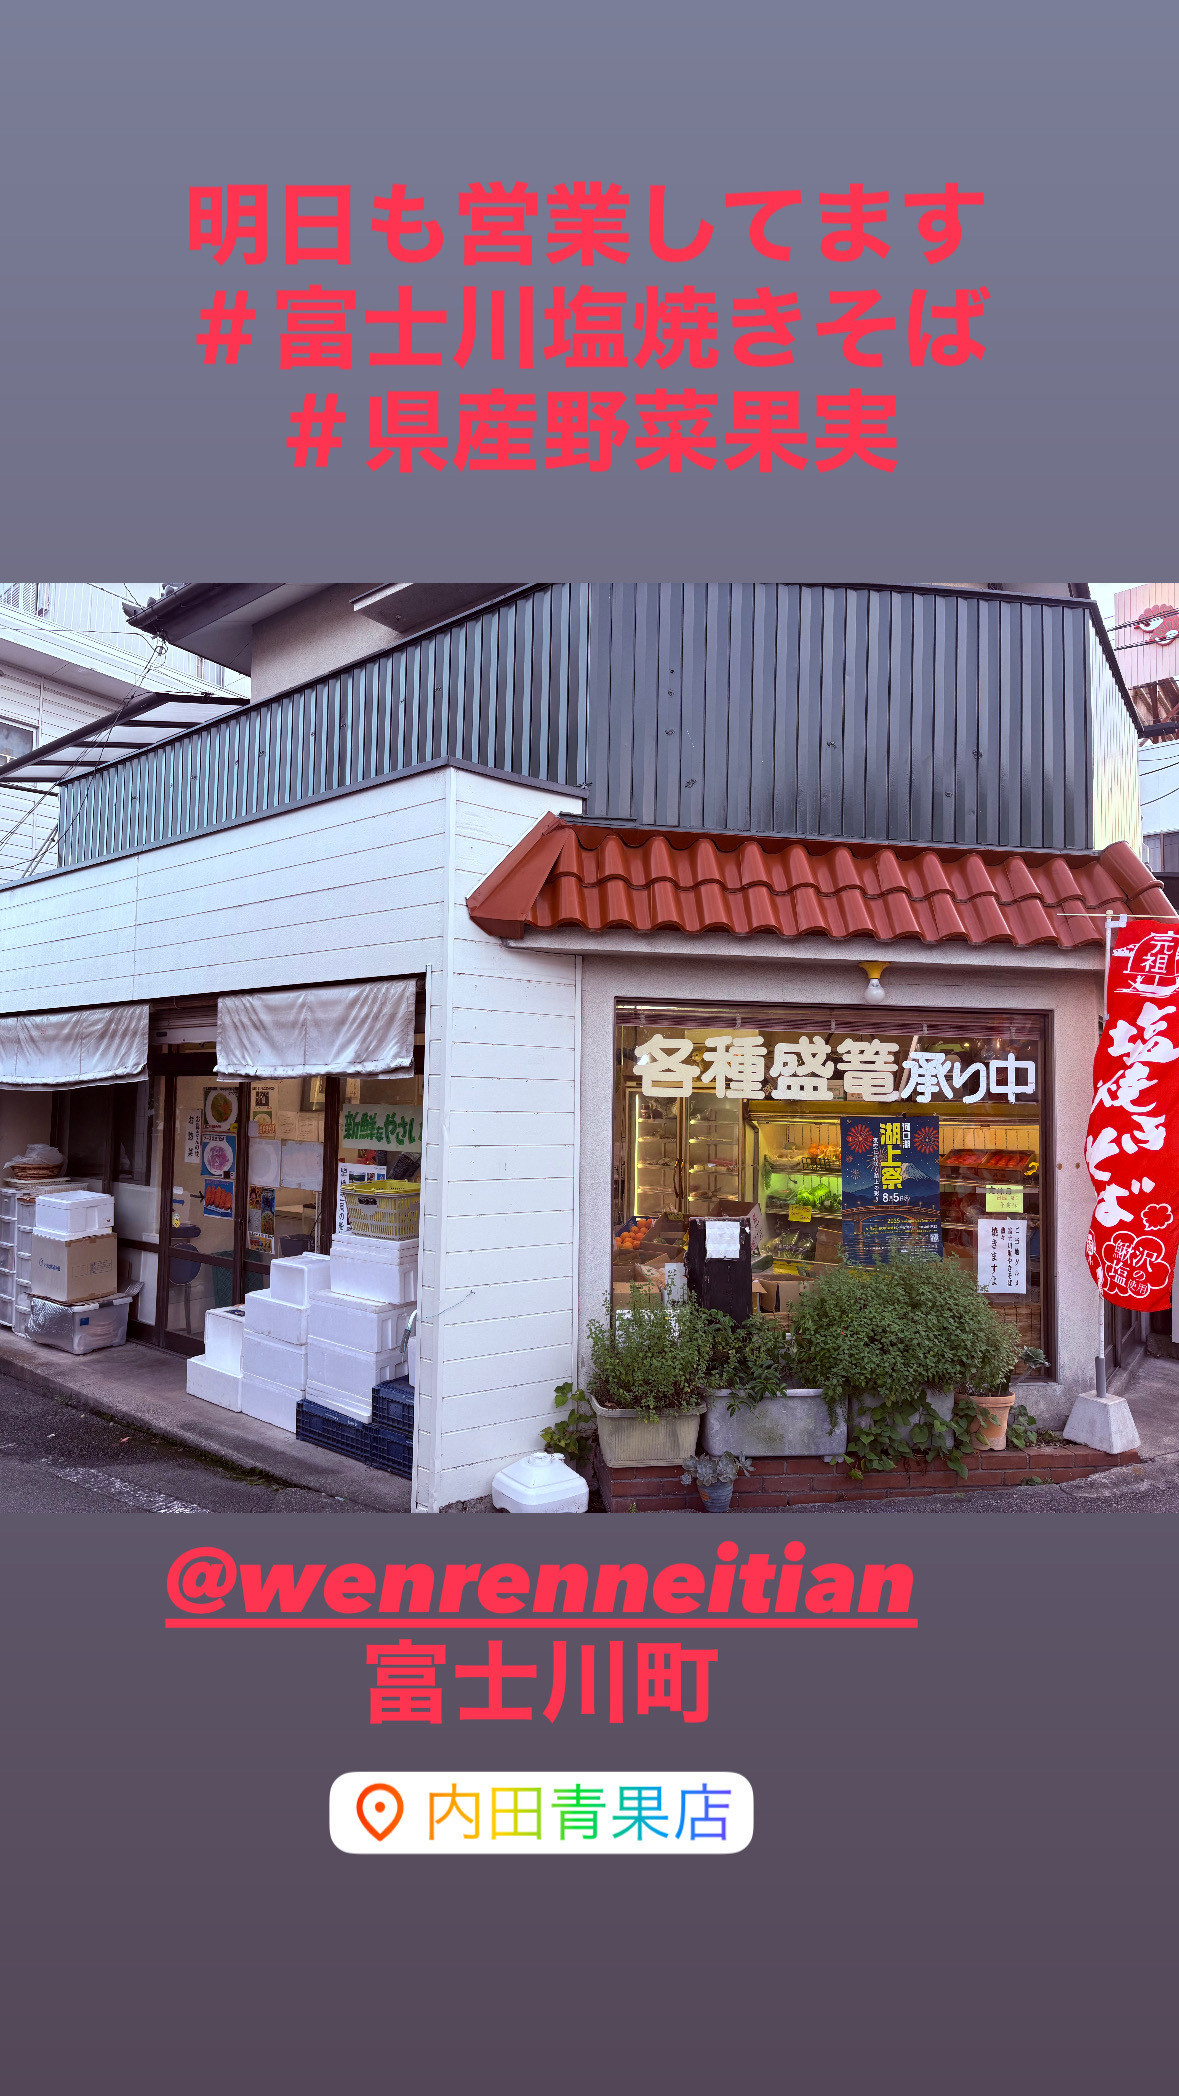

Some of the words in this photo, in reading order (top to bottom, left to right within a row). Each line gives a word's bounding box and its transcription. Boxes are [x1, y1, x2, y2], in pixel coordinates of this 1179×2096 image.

[1140, 936, 1174, 973] 元祖
[880, 1123, 902, 1189] 湖上祭
